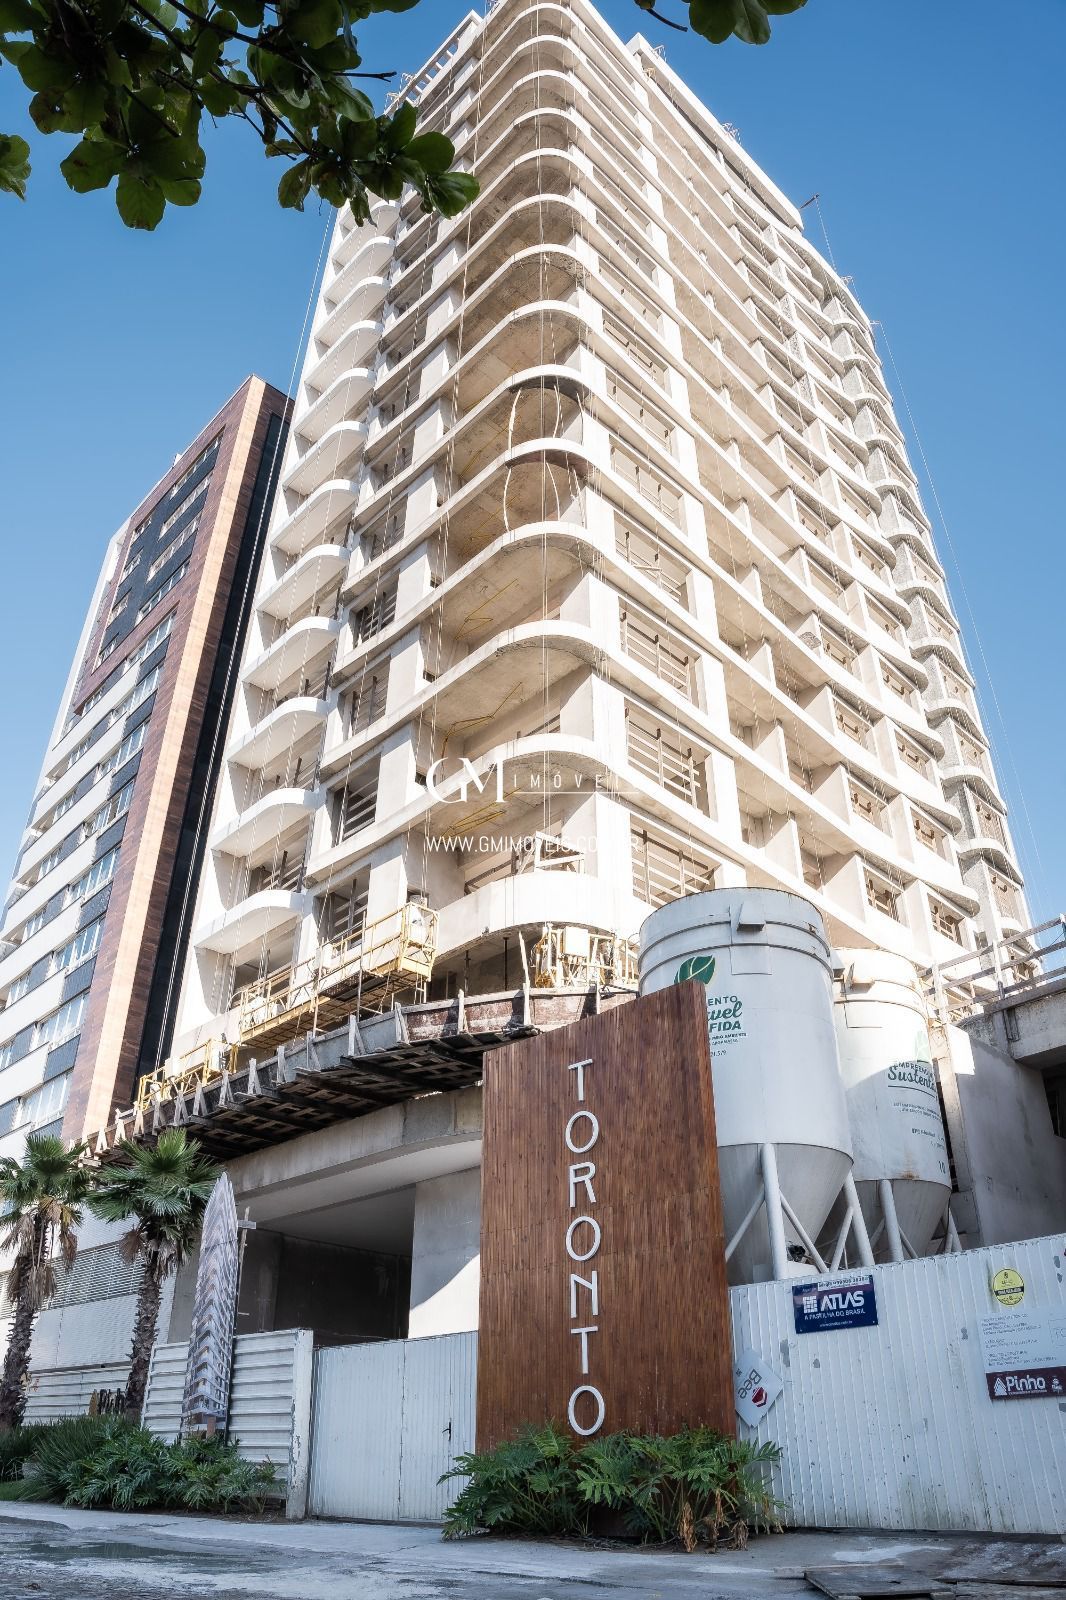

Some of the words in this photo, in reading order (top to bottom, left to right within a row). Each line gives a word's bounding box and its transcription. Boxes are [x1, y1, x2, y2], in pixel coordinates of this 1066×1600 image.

[707, 995, 738, 1006] ENTO
[709, 1020, 742, 1033] FIDA
[887, 1065, 936, 1093] Sustent
[565, 1058, 605, 1436] TORONTO
[820, 1290, 865, 1312] ATLAS
[1005, 1374, 1046, 1392] Pinho
